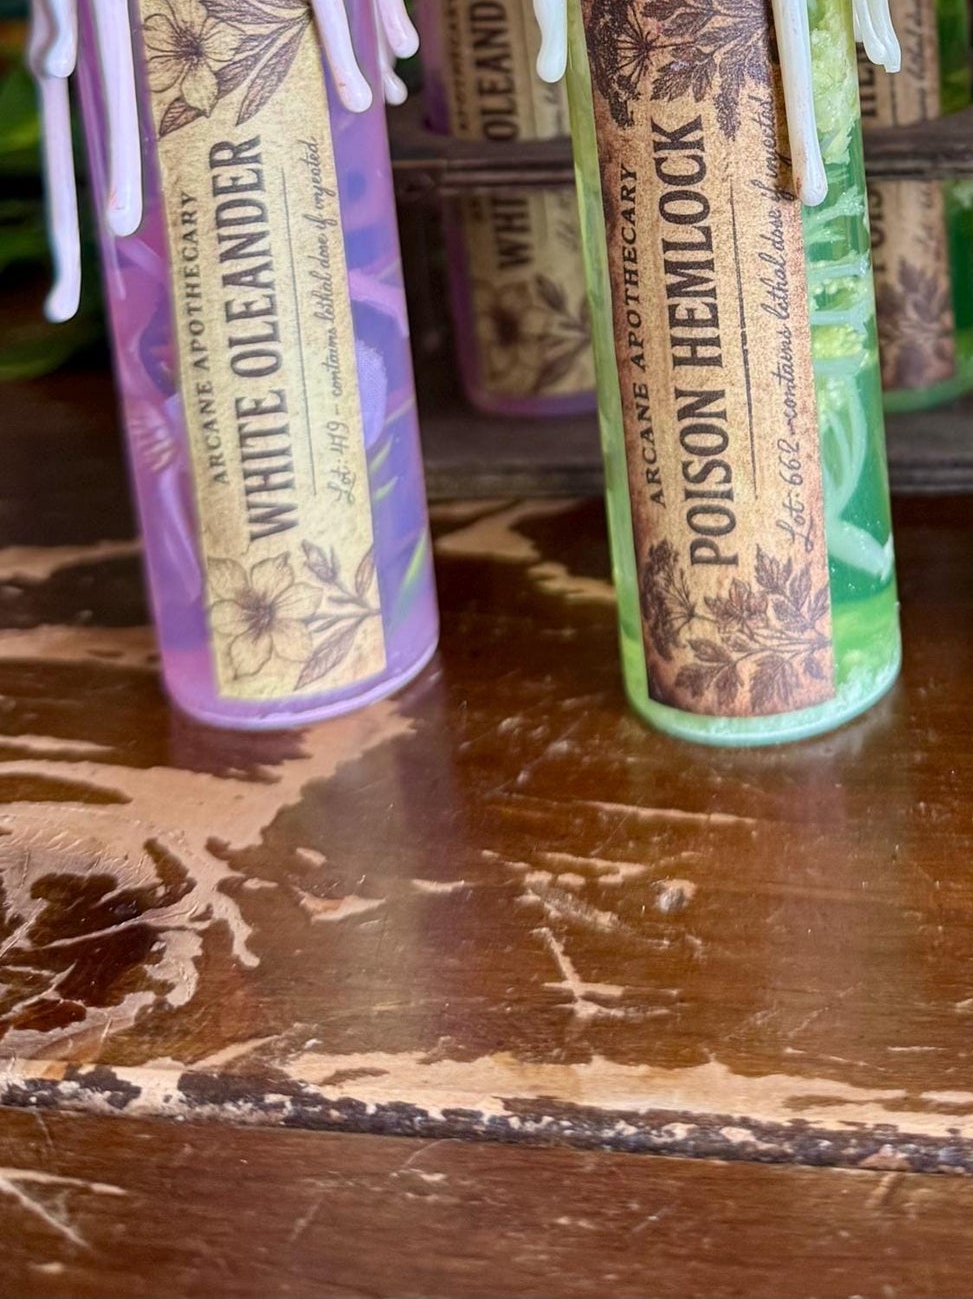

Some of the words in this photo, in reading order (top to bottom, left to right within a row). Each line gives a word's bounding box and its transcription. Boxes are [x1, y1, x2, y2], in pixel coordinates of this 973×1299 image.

[748, 93, 791, 179] injected
[304, 213, 337, 233] if
[751, 179, 796, 210] if
[759, 209, 786, 251] dose
[208, 135, 283, 379] OLEANDER
[309, 231, 332, 270] dose
[619, 163, 648, 371] APOTHECARY
[651, 114, 724, 369] HEMLOCK
[180, 191, 210, 371] APOTHECARY
[312, 271, 336, 322] lethal
[758, 250, 791, 319] lethal
[322, 327, 343, 398] contains
[771, 326, 799, 420] contains
[195, 381, 230, 485] ARCANE
[234, 389, 299, 543] WHITE
[327, 419, 349, 455] 419
[632, 383, 666, 509] ARCANE
[777, 439, 804, 486] 662
[329, 461, 356, 506] Lot:
[674, 388, 739, 567] POISON
